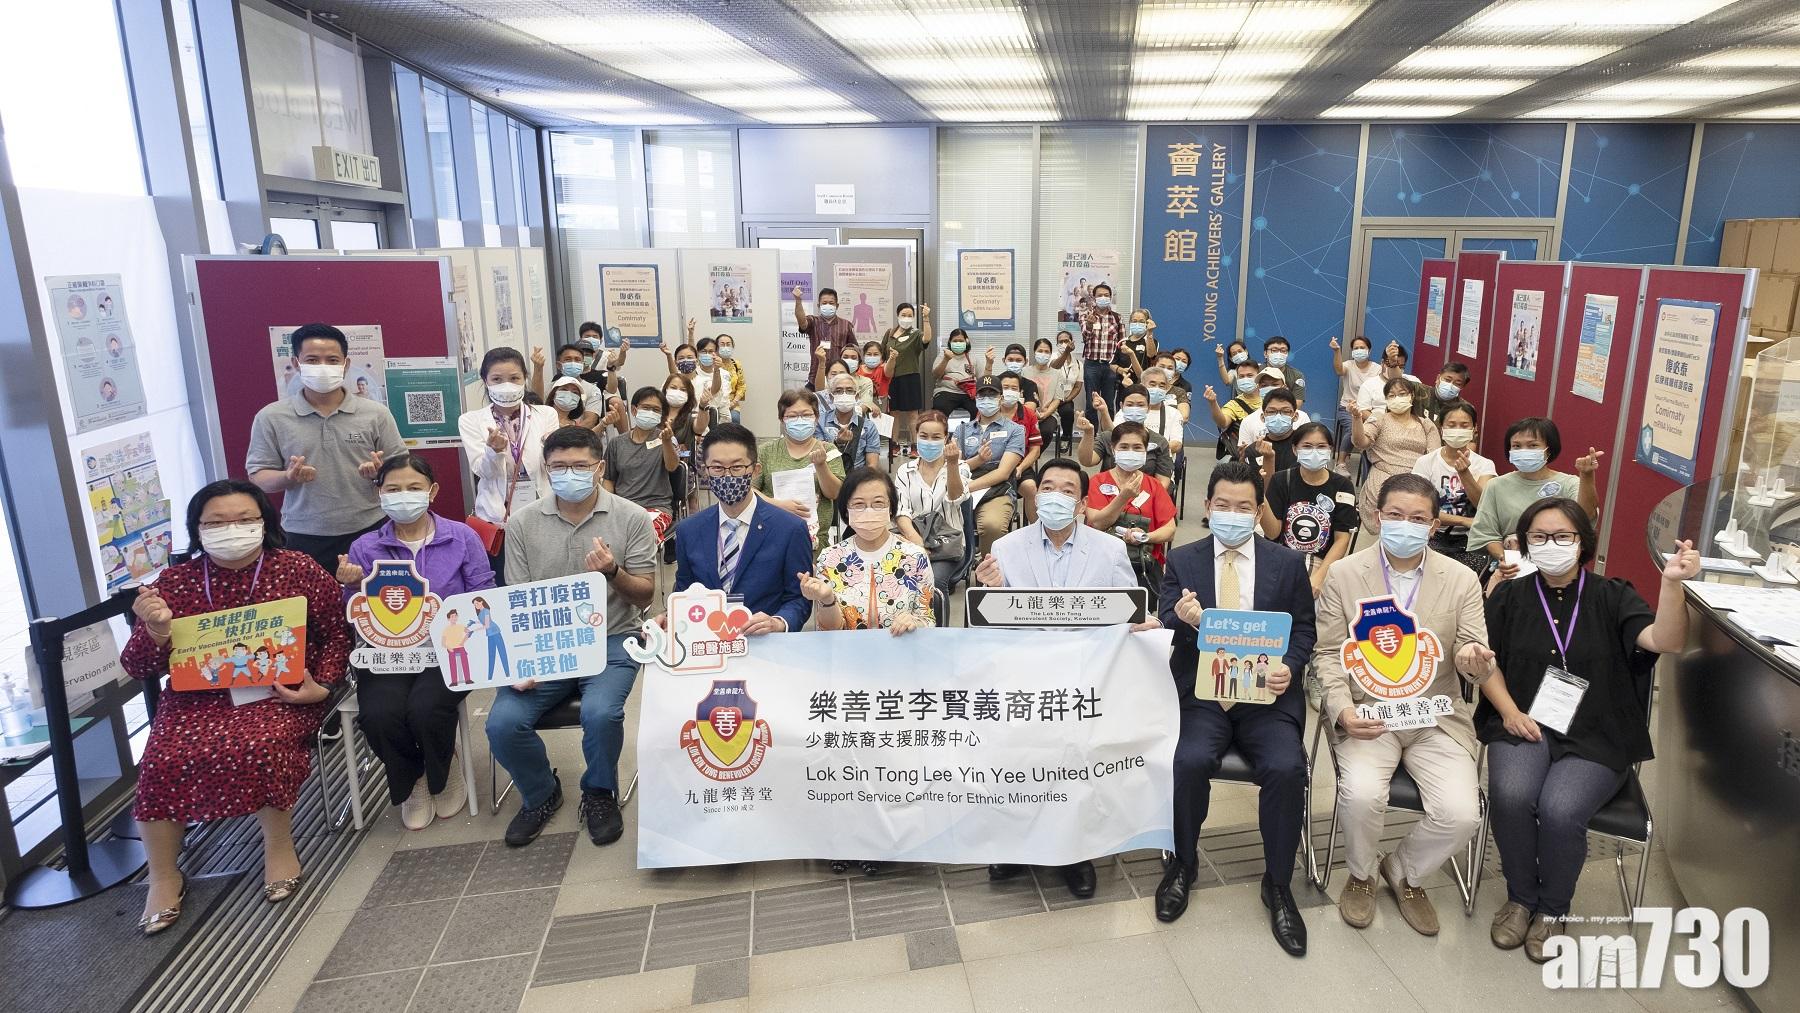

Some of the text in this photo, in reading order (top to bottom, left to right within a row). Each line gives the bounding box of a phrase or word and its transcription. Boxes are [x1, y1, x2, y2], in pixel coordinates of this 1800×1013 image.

[335, 153, 379, 183] EXIT 出口
[1210, 143, 1227, 206] GALLERY
[1163, 143, 1202, 262] 薈萃館
[617, 314, 646, 322] Comirnaty
[1203, 292, 1218, 342] YOUNG
[786, 341, 806, 350] Zone
[783, 362, 810, 372] 休息區
[1655, 403, 1685, 425] Comirnaty
[384, 587, 408, 611] 善
[508, 581, 591, 610] 齊打疫苗
[1007, 595, 1107, 610] 九龍樂善堂
[197, 608, 257, 632] 全城起動
[225, 615, 284, 638] 快打疫苗
[511, 606, 573, 633] 誇啦啦
[1205, 616, 1267, 634] Let's get
[177, 646, 197, 655] Early
[198, 637, 241, 650] Vaccination
[255, 631, 265, 639] All
[514, 626, 597, 653] 一起保障
[692, 638, 746, 656] 贈醫施藥
[1205, 634, 1284, 648] vaccinated
[1375, 627, 1399, 654] 善
[354, 651, 439, 664] 九龍樂善堂
[516, 652, 578, 679] 你我他
[63, 660, 116, 688] ervation area
[808, 687, 1103, 722] 樂善堂李賢義裔群社
[1359, 698, 1451, 720] 九龍樂善堂
[714, 709, 738, 737] 善
[1400, 719, 1417, 727] 1880
[805, 729, 981, 749] 少數族裔支援服務中心
[718, 766, 754, 780] BENEVOLENT
[806, 754, 1145, 786] Lok Sin Tong Lee Yin Yee United Centre
[685, 786, 773, 805] 九龍樂善堂
[807, 790, 1068, 805] Support Service Centre for Ethnic Minorities
[703, 804, 755, 815] Since 1880 成立
